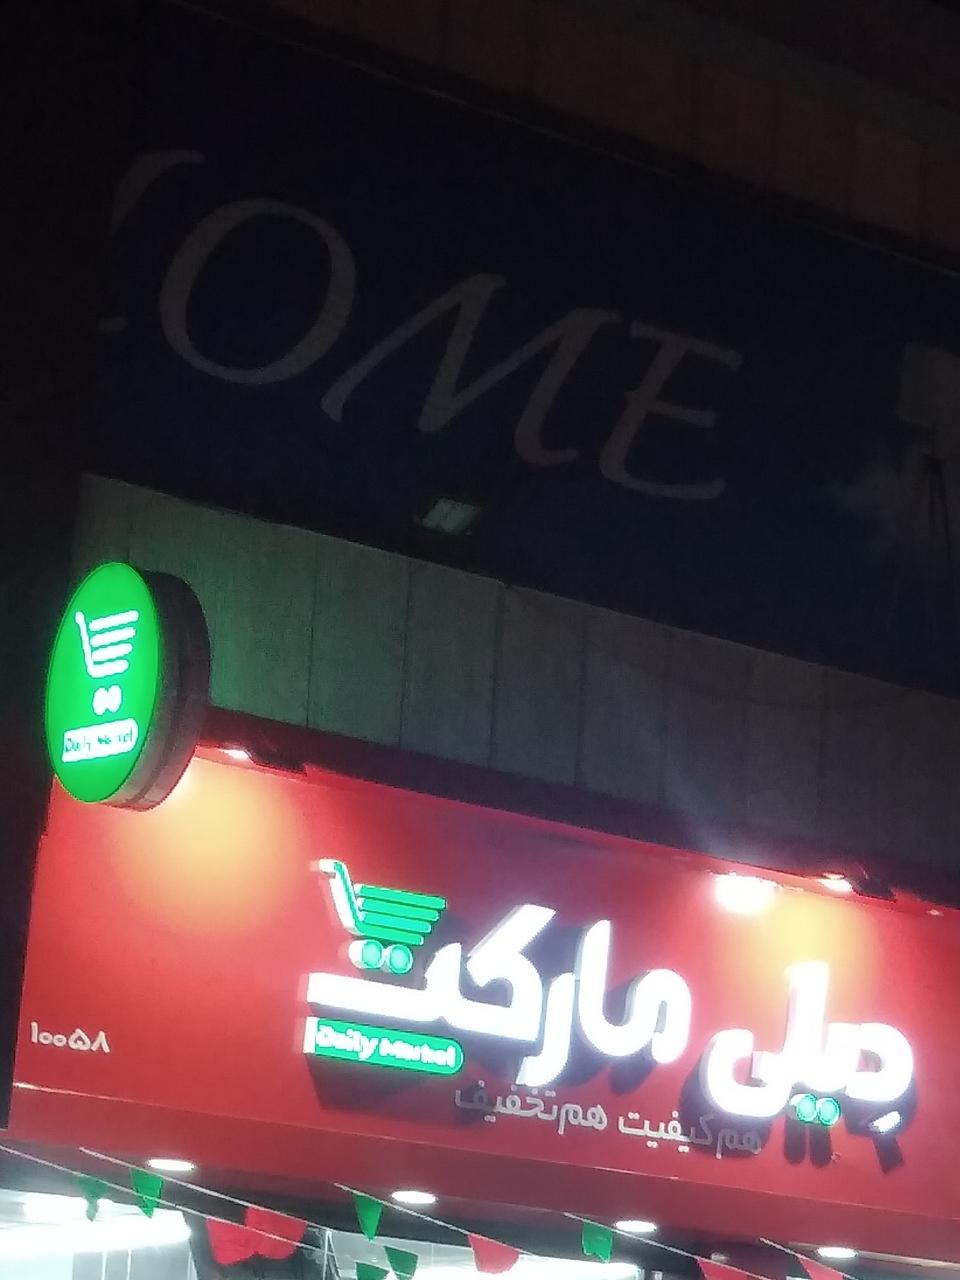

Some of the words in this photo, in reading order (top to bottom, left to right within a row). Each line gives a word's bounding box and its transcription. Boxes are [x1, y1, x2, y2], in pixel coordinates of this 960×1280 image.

[315, 1025, 379, 1061] Daily
[379, 1037, 456, 1069] Market
[455, 1080, 558, 1122] تخفیف
[557, 1103, 608, 1135] هم
[618, 1110, 714, 1153] کیفیت
